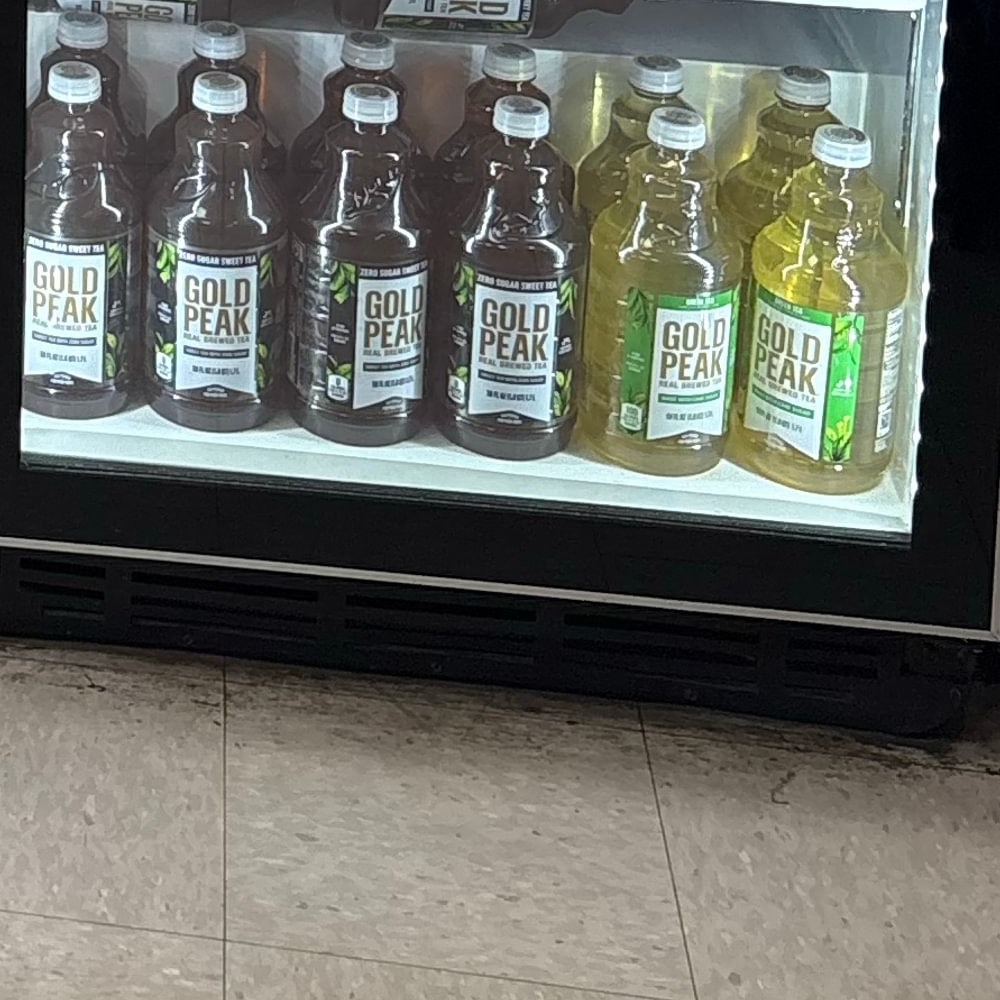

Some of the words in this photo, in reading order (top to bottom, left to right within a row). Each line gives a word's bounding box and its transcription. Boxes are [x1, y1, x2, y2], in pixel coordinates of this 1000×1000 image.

[33, 260, 99, 296] GOLD
[221, 256, 244, 266] SWEET
[359, 268, 379, 278] ZERO
[379, 267, 401, 278] SUGAR
[184, 275, 251, 308] GOLD
[476, 273, 495, 286] ZERO
[495, 278, 520, 290] SUGAR
[520, 281, 545, 291] SWEET
[545, 280, 558, 290] TEA
[32, 290, 99, 324] PEAK
[365, 284, 424, 320] GOLD
[481, 298, 550, 333] GOLD
[183, 303, 252, 336] PEAK
[363, 313, 422, 348] PEAK
[662, 317, 726, 351] GOLD
[480, 327, 549, 362] PEAK
[758, 313, 821, 364] GOLD
[498, 360, 532, 370] BREWED
[534, 362, 547, 370] TEA
[660, 347, 723, 381] PEAK
[754, 342, 819, 395] PEAK
[658, 380, 679, 389] REAL
[801, 394, 816, 404] TEA
